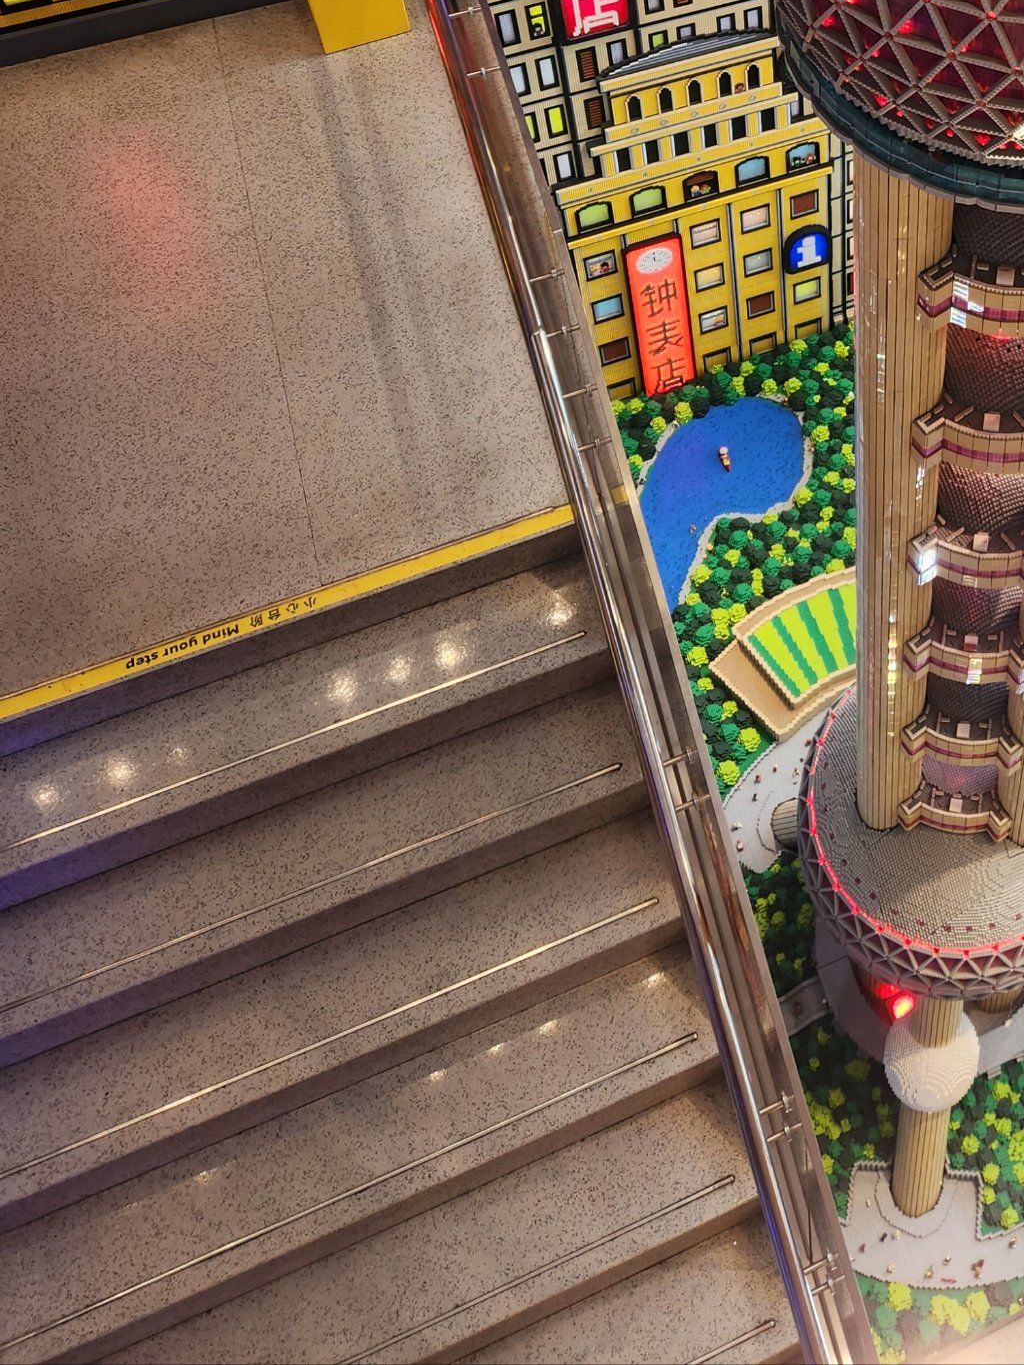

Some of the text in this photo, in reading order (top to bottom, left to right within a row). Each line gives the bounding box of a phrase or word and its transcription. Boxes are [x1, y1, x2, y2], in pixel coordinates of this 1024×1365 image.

[640, 279, 686, 392] 钟表店
[250, 596, 316, 628] 小心台阶
[125, 624, 240, 669] Mind your step
